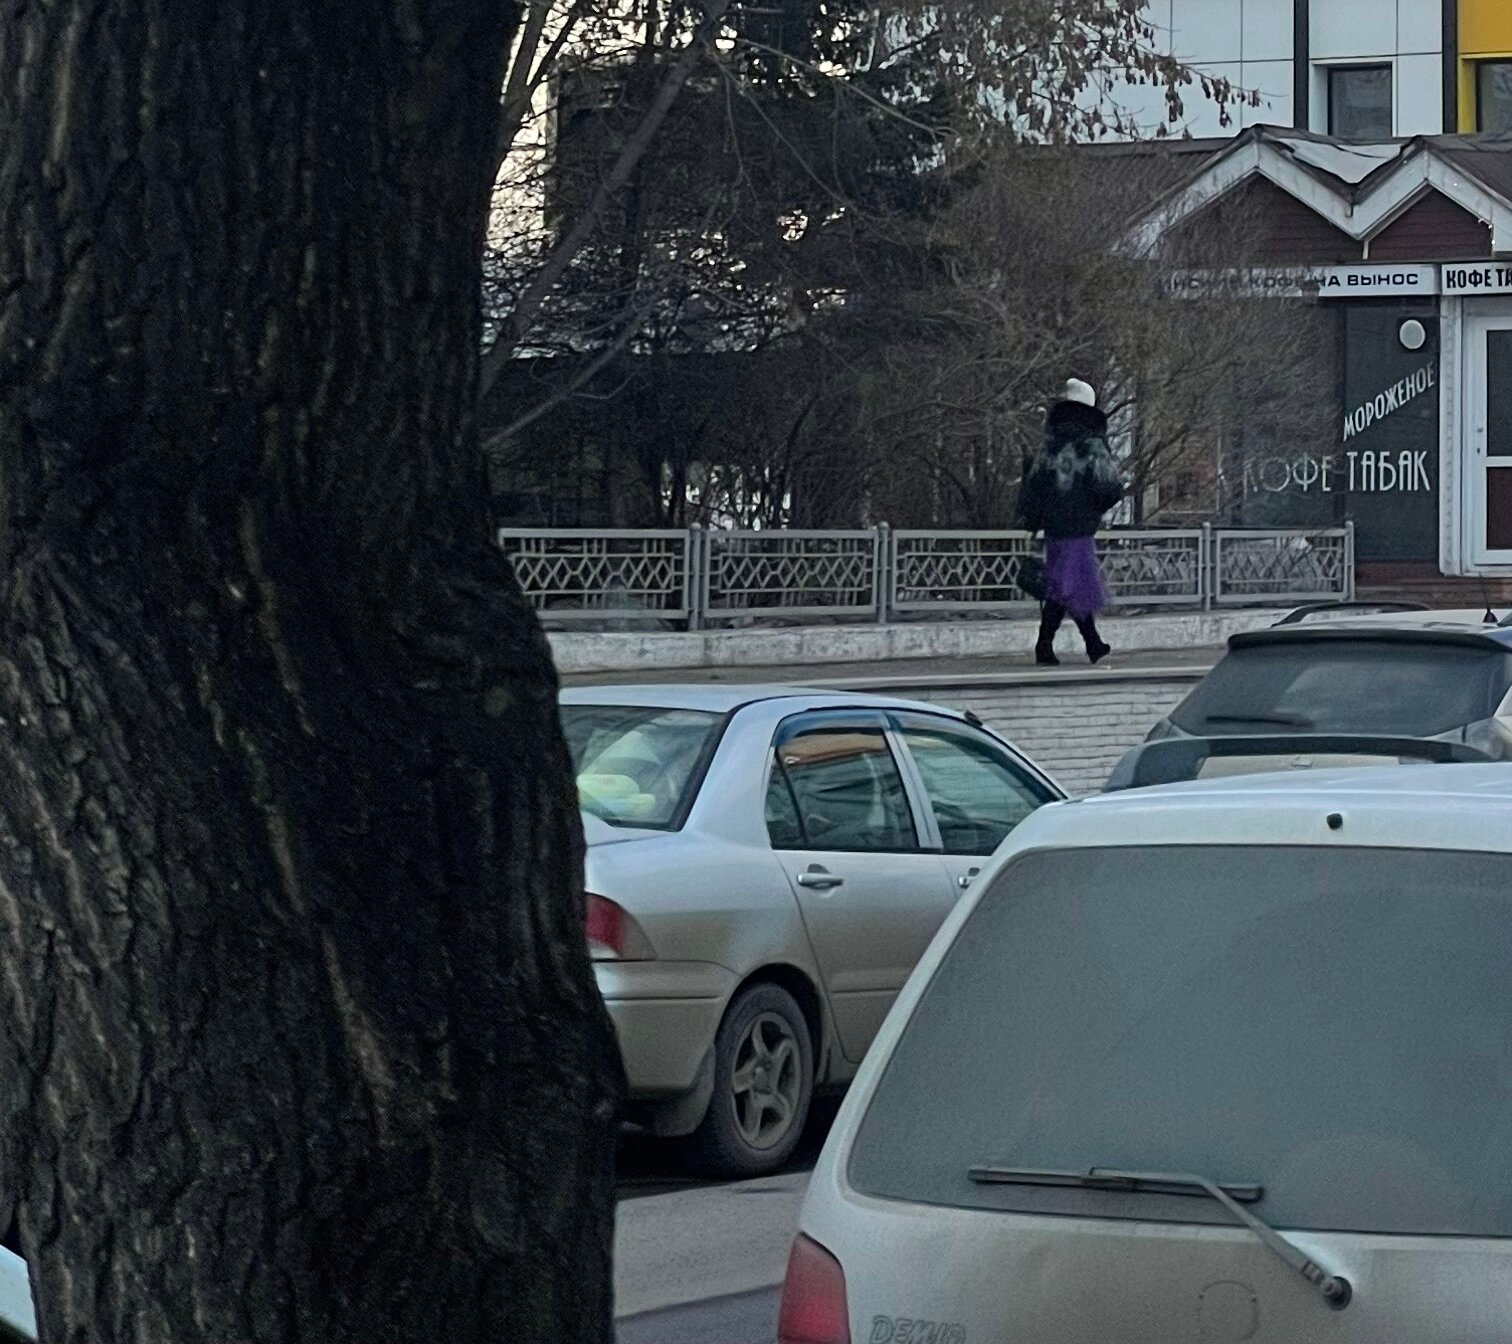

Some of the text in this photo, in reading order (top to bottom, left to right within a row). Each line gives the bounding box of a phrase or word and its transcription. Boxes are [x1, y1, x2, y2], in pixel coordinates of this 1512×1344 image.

[1347, 273, 1419, 287] ВЫНОС
[1446, 269, 1492, 289] КОФЕ
[1343, 363, 1435, 442] МОРОЖЕНОЕ
[1346, 450, 1431, 492] ТАБАК
